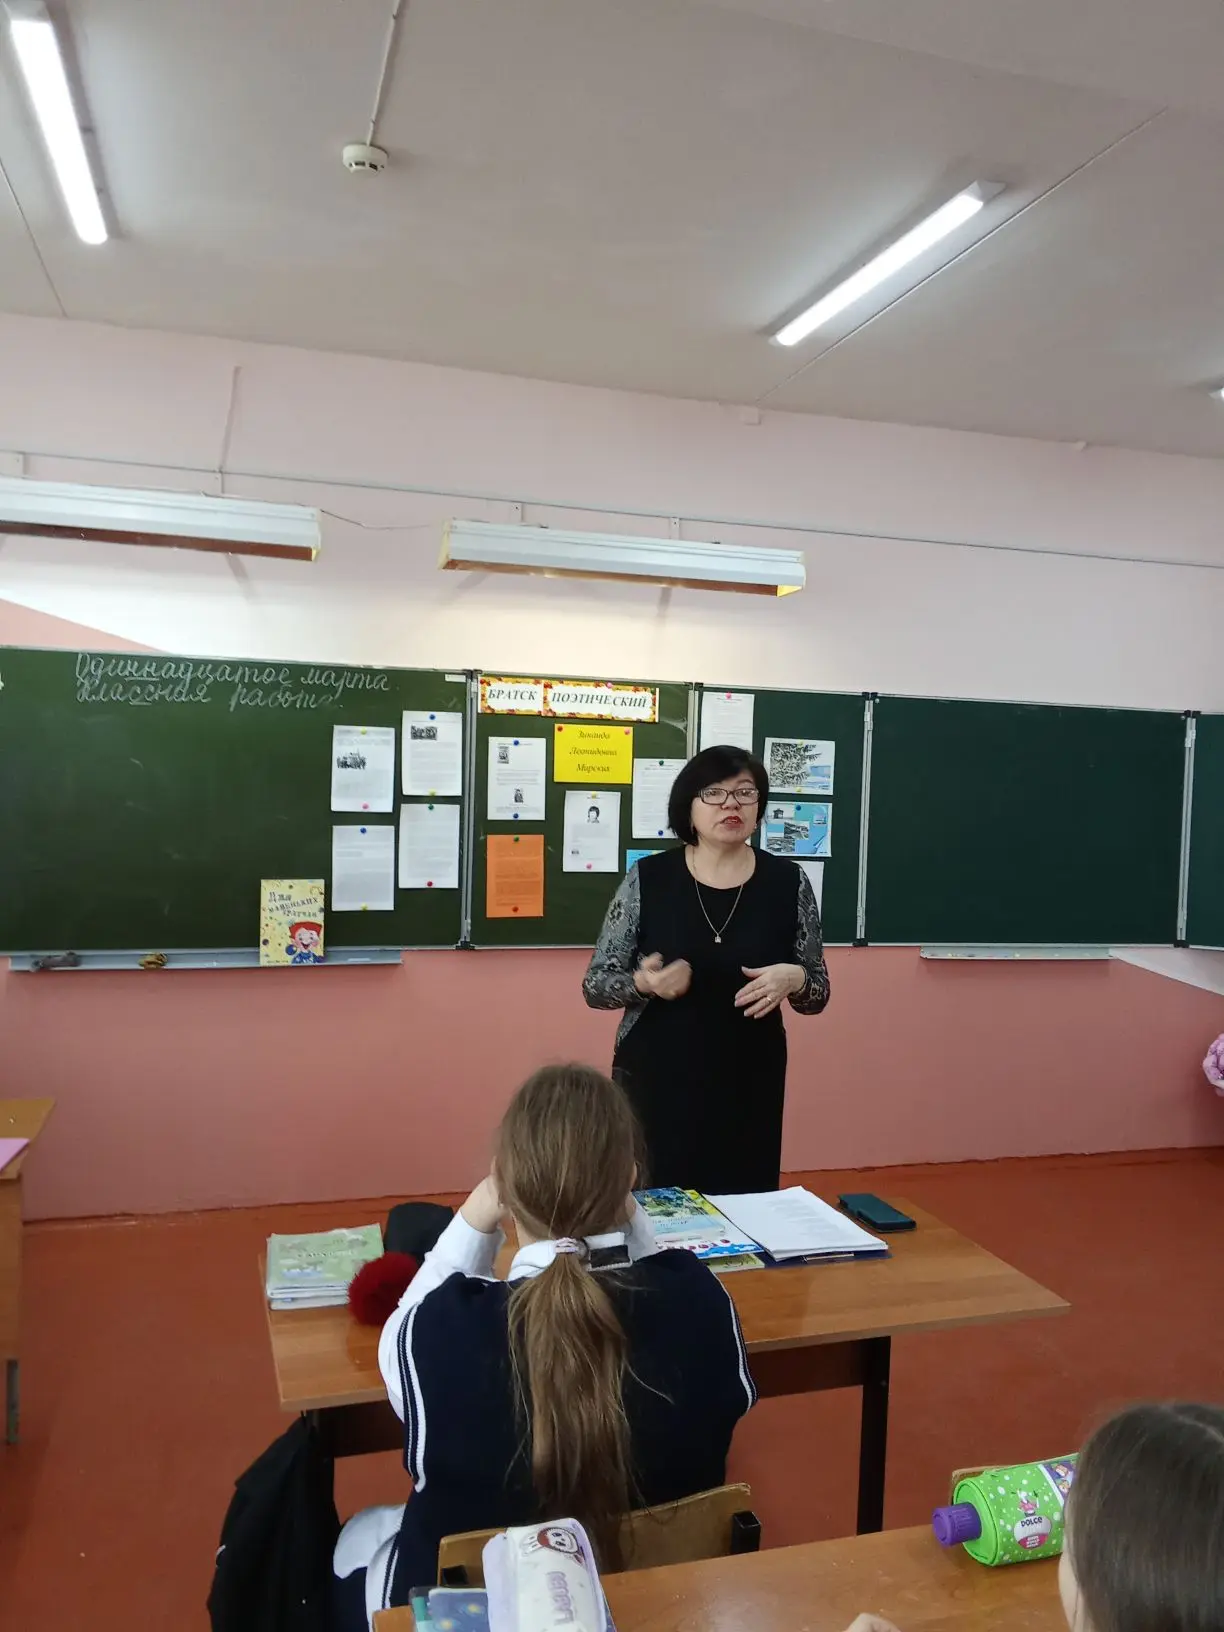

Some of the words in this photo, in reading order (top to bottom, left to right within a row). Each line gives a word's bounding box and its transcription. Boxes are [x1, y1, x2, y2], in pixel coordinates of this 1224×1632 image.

[75, 652, 295, 687] Одиннадцатое
[76, 679, 211, 705] Классная
[488, 689, 538, 701] БРАТСК
[551, 691, 648, 708] ПОЭТИЧЕСКИЙ
